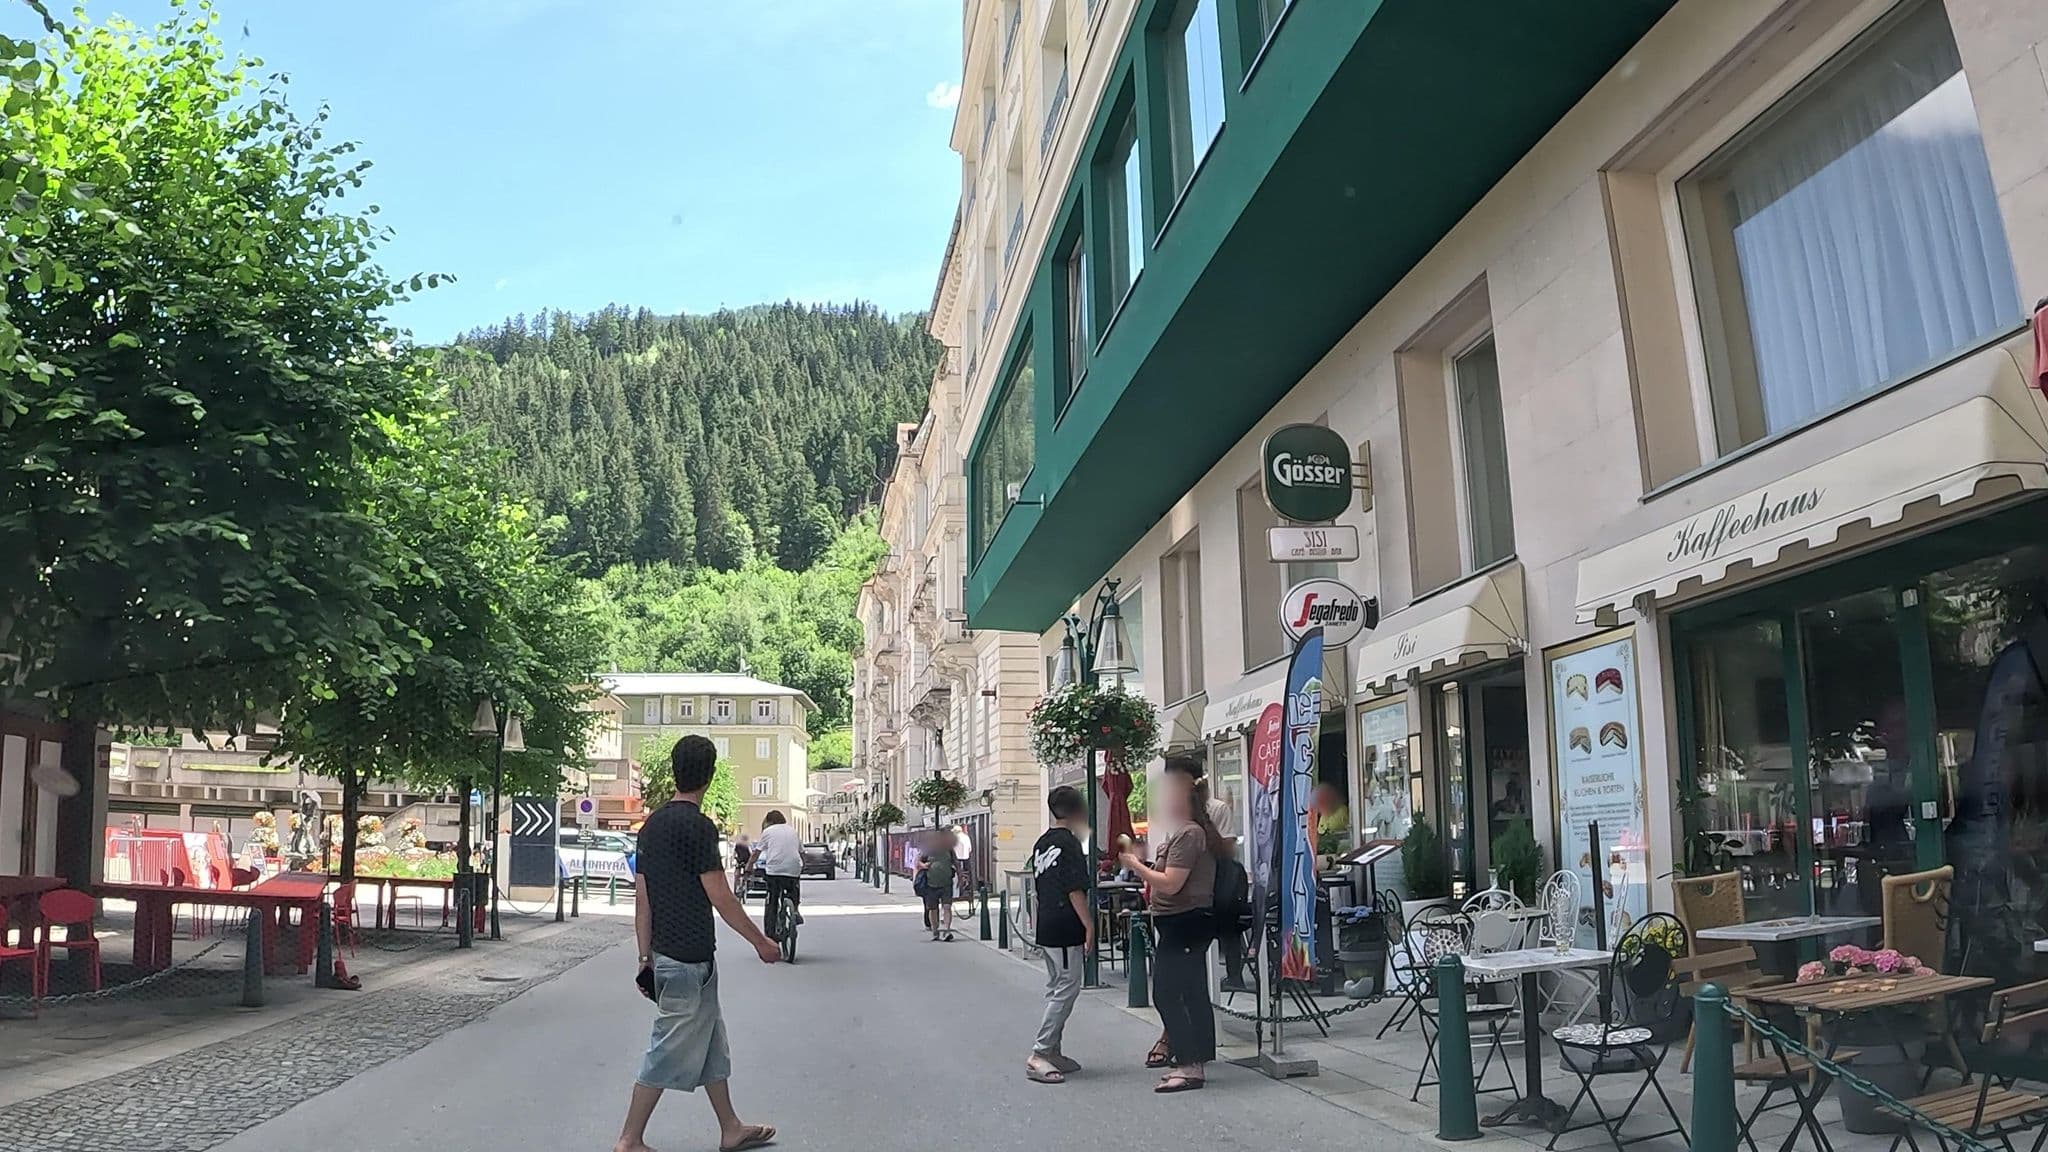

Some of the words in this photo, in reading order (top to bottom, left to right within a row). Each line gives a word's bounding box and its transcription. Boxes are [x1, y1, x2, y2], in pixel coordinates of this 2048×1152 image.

[1272, 452, 1345, 487] Gösser
[1303, 530, 1328, 548] SISI
[1667, 487, 1826, 562] Kaffeehaus
[1292, 592, 1359, 627] Segafredo
